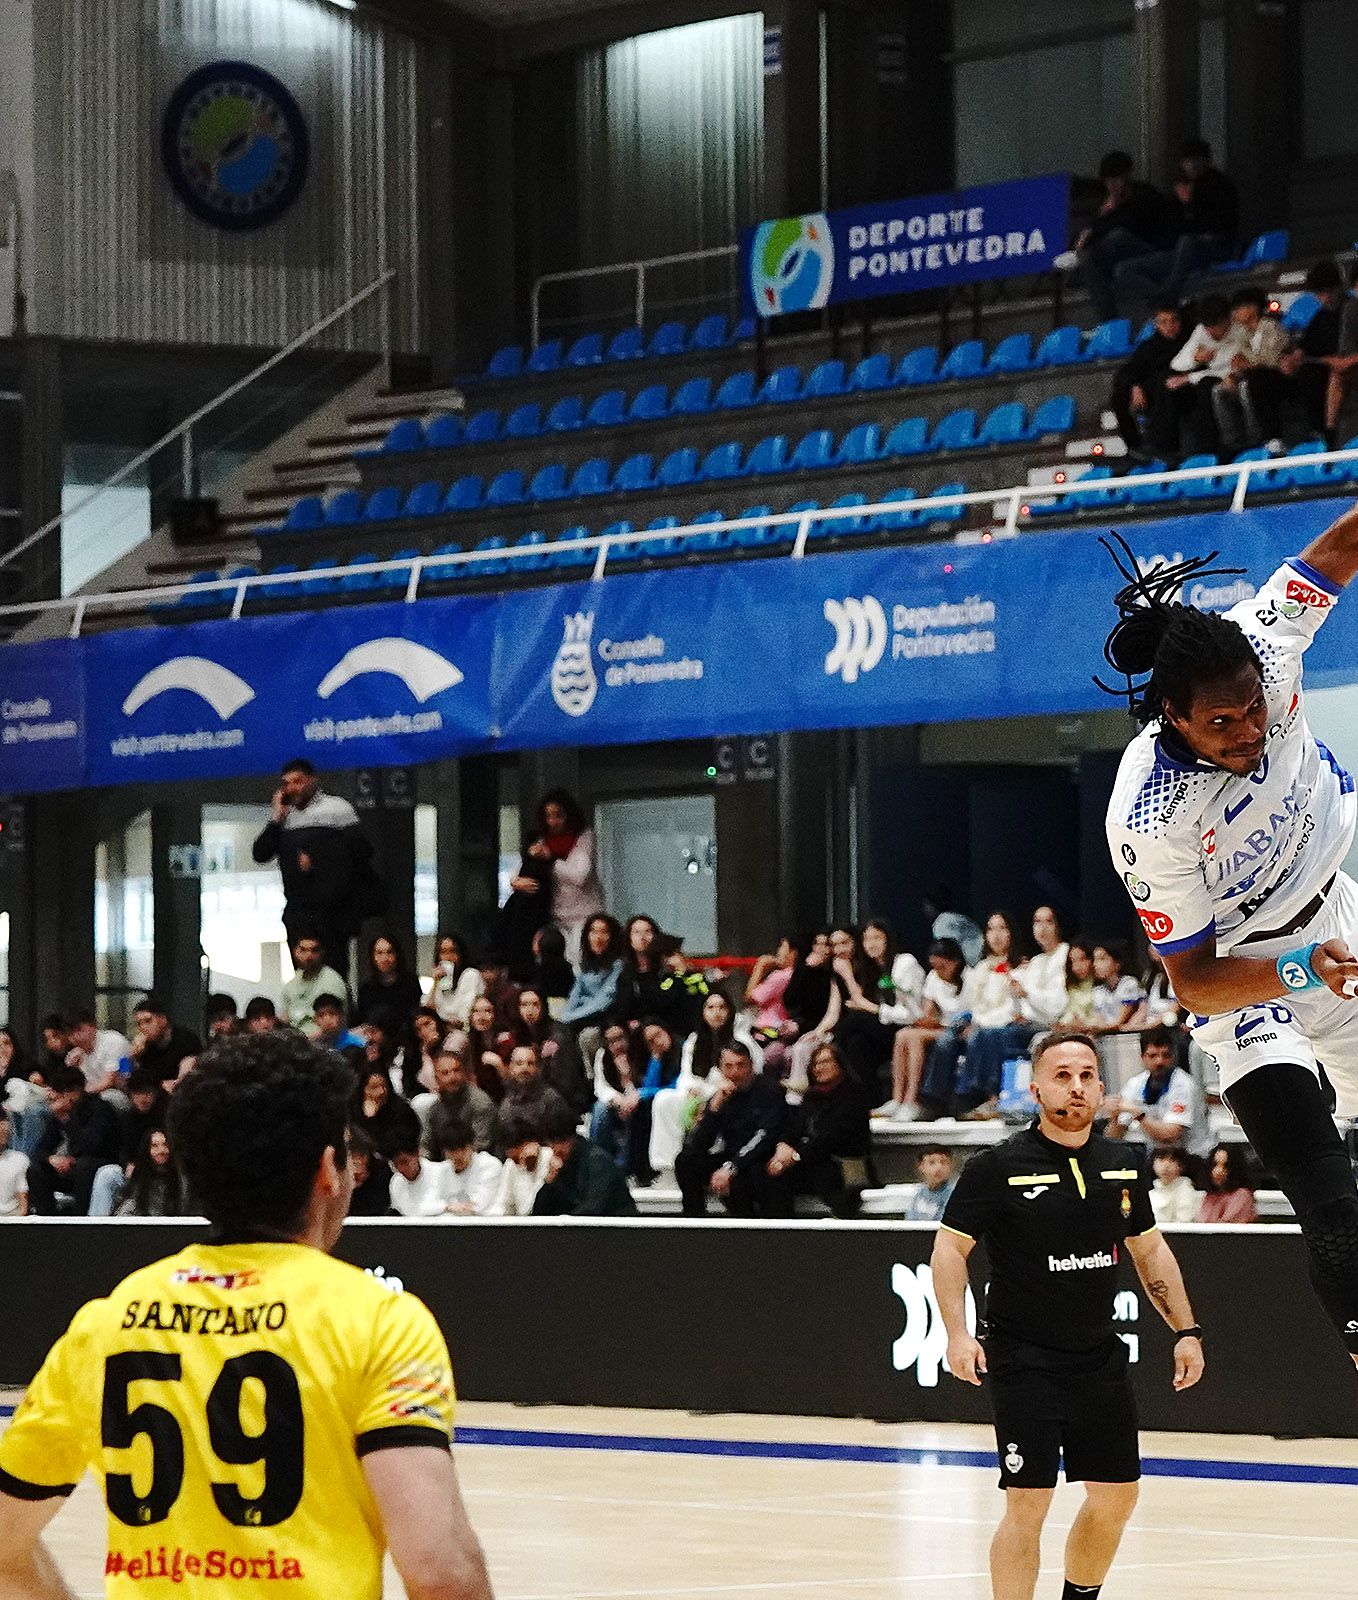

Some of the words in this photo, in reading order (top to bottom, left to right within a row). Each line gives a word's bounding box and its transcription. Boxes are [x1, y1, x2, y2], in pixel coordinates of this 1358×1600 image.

[849, 207, 984, 250] DEPORTE
[849, 228, 1047, 281] PONTEVEDRA
[1158, 782, 1189, 825] Kempa
[1236, 1031, 1278, 1052] Kempa
[1048, 1250, 1112, 1272] helvetia
[101, 1350, 305, 1527] 59
[105, 1545, 304, 1583] #eligeSoria
